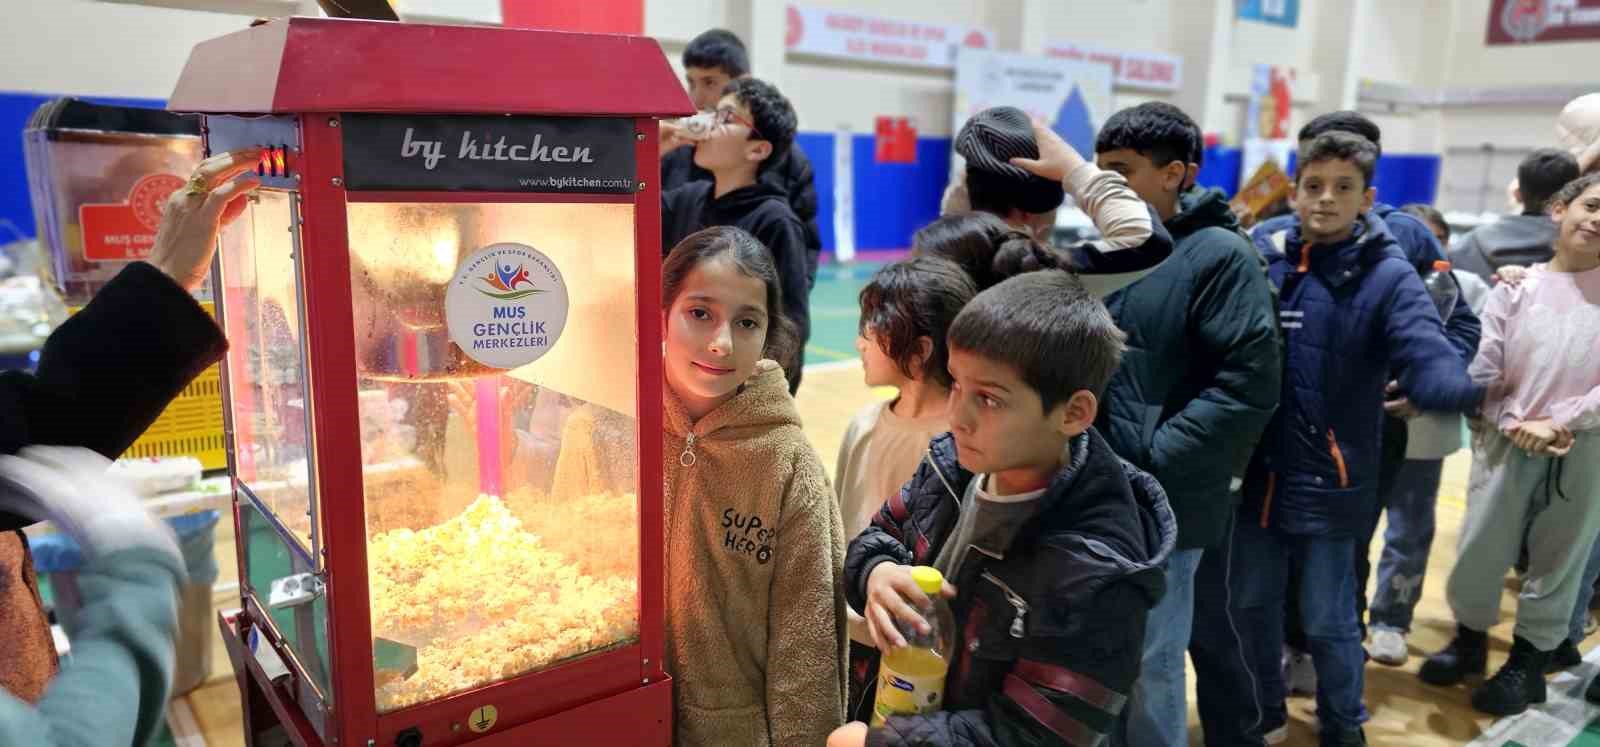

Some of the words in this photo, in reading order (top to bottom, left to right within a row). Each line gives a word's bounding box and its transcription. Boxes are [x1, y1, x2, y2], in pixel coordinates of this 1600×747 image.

[400, 127, 446, 171] by
[458, 129, 593, 164] kitchen
[519, 177, 633, 190] www.bykitchen.com.tr
[493, 306, 526, 320] MUŞ
[473, 321, 546, 337] GENÇLİK
[473, 336, 548, 350] MERKEZLERİ
